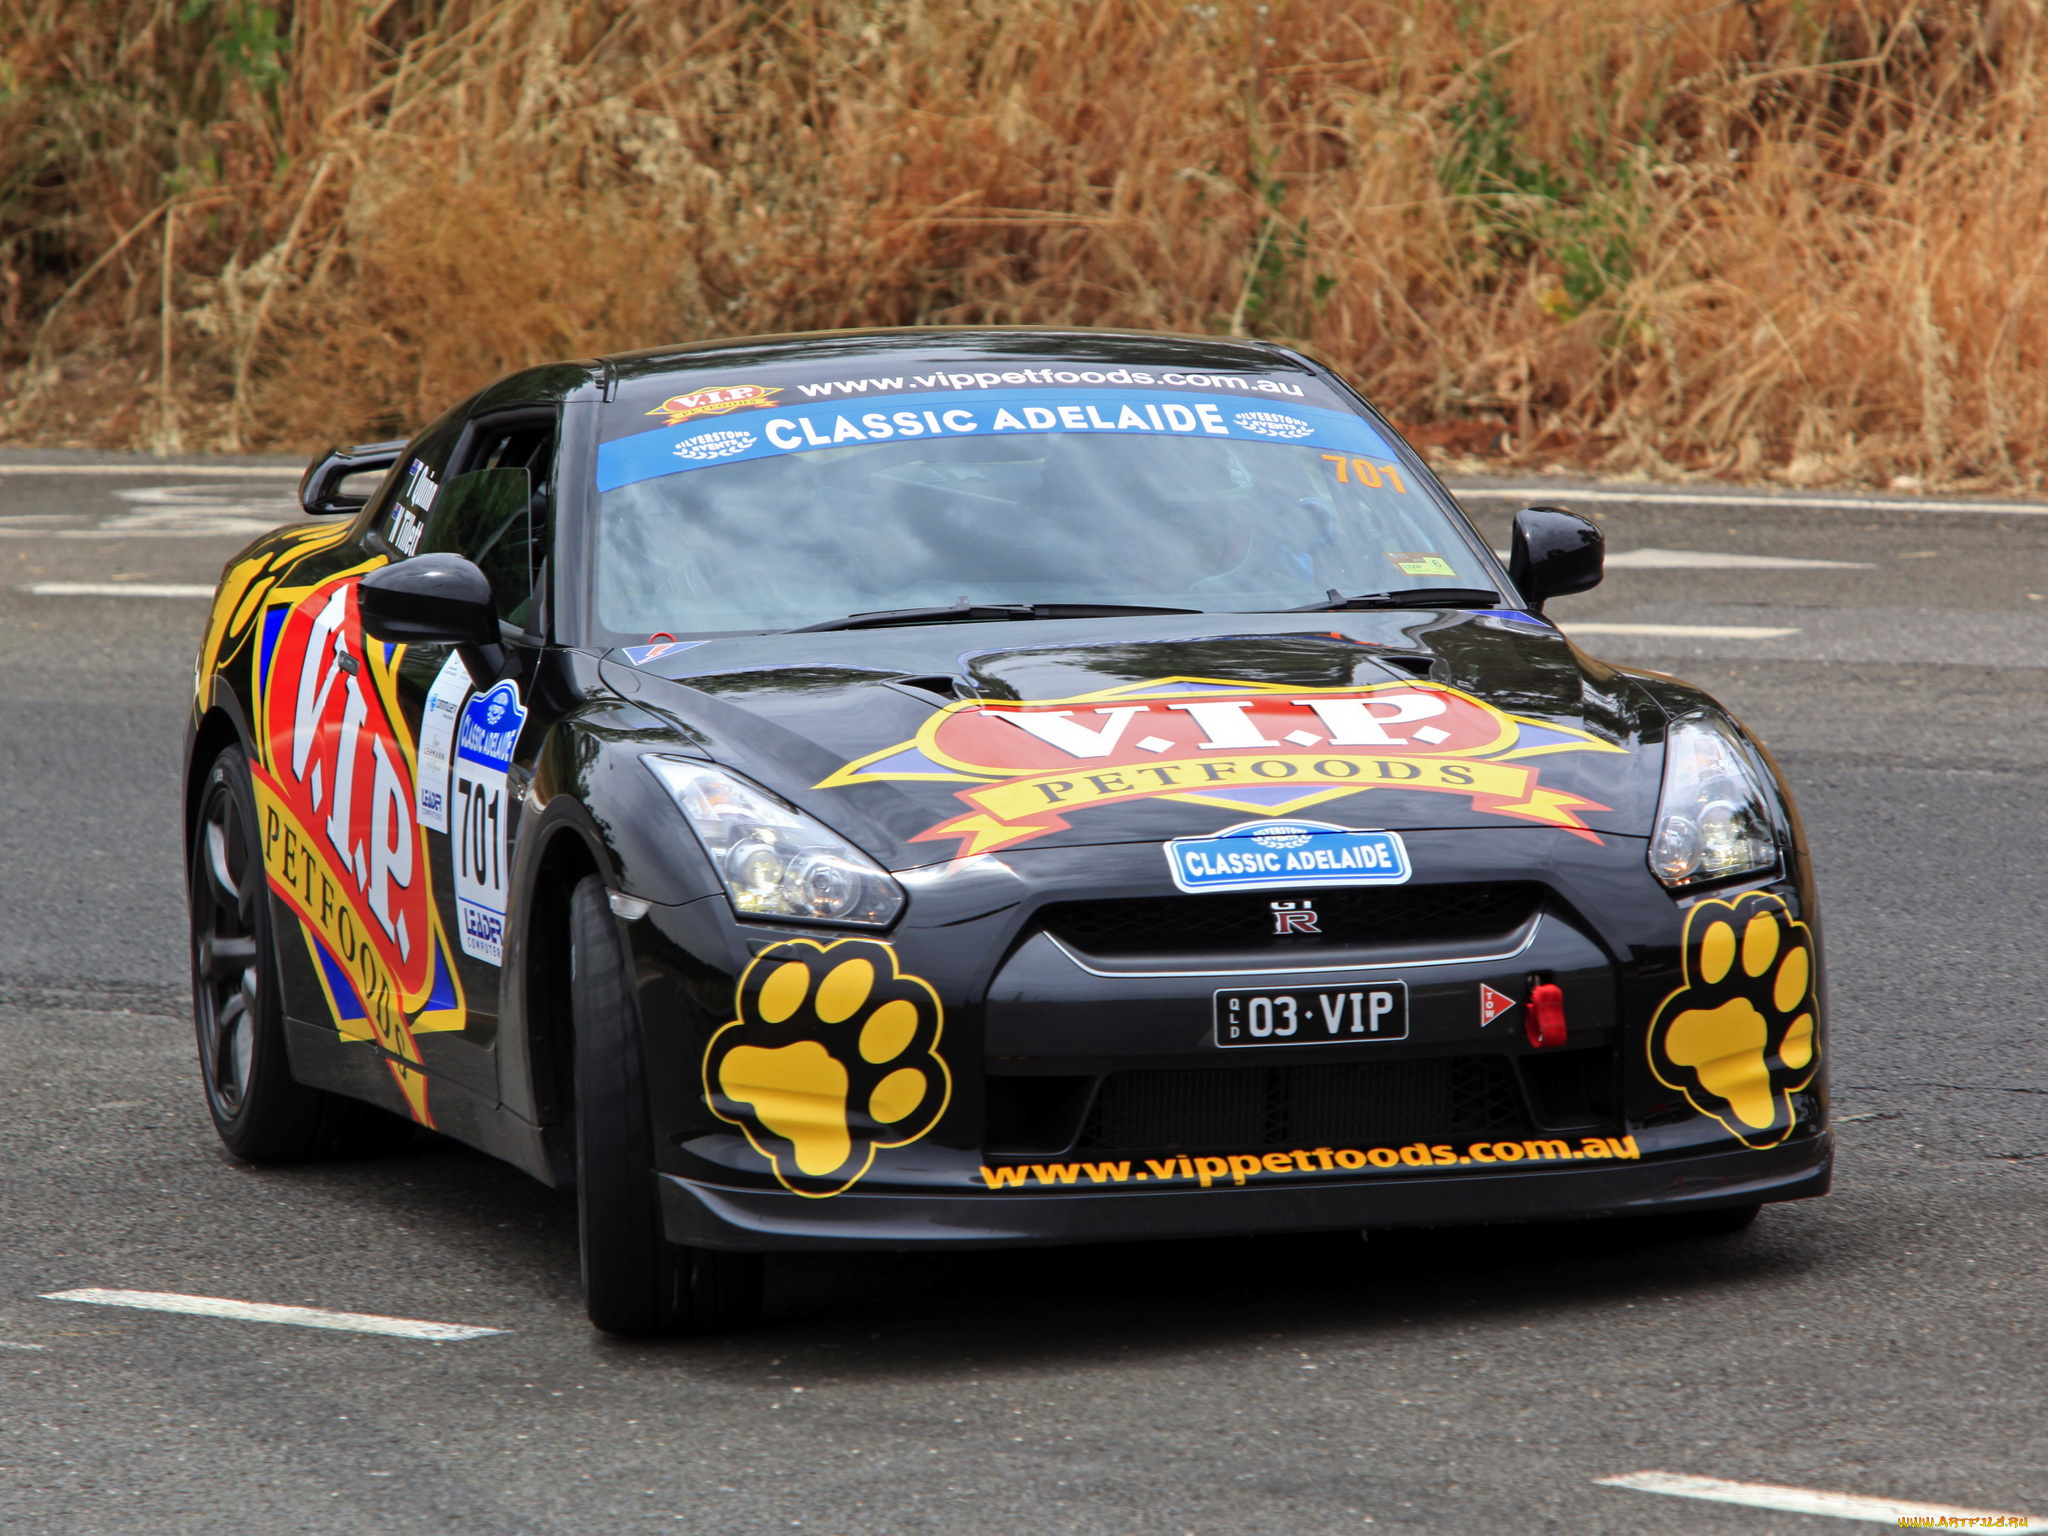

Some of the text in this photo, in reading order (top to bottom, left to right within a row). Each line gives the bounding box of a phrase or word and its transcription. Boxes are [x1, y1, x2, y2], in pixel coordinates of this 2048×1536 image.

[797, 368, 1305, 397] www.vippetfoods.com.au
[765, 403, 1230, 450] CLASSIC ADELAIDE
[1322, 454, 1405, 494] 701
[977, 692, 1452, 753] V.I.P.
[1033, 759, 1475, 803] PETFOODS
[458, 778, 500, 891] 701
[1186, 843, 1392, 876] CLASSIC ADELAIDE
[265, 804, 408, 1080] PETFOODS
[467, 937, 501, 958] COMPUTER
[1485, 992, 1495, 1018] TOW
[979, 1136, 1640, 1188] www.vippetfoods.com.au
